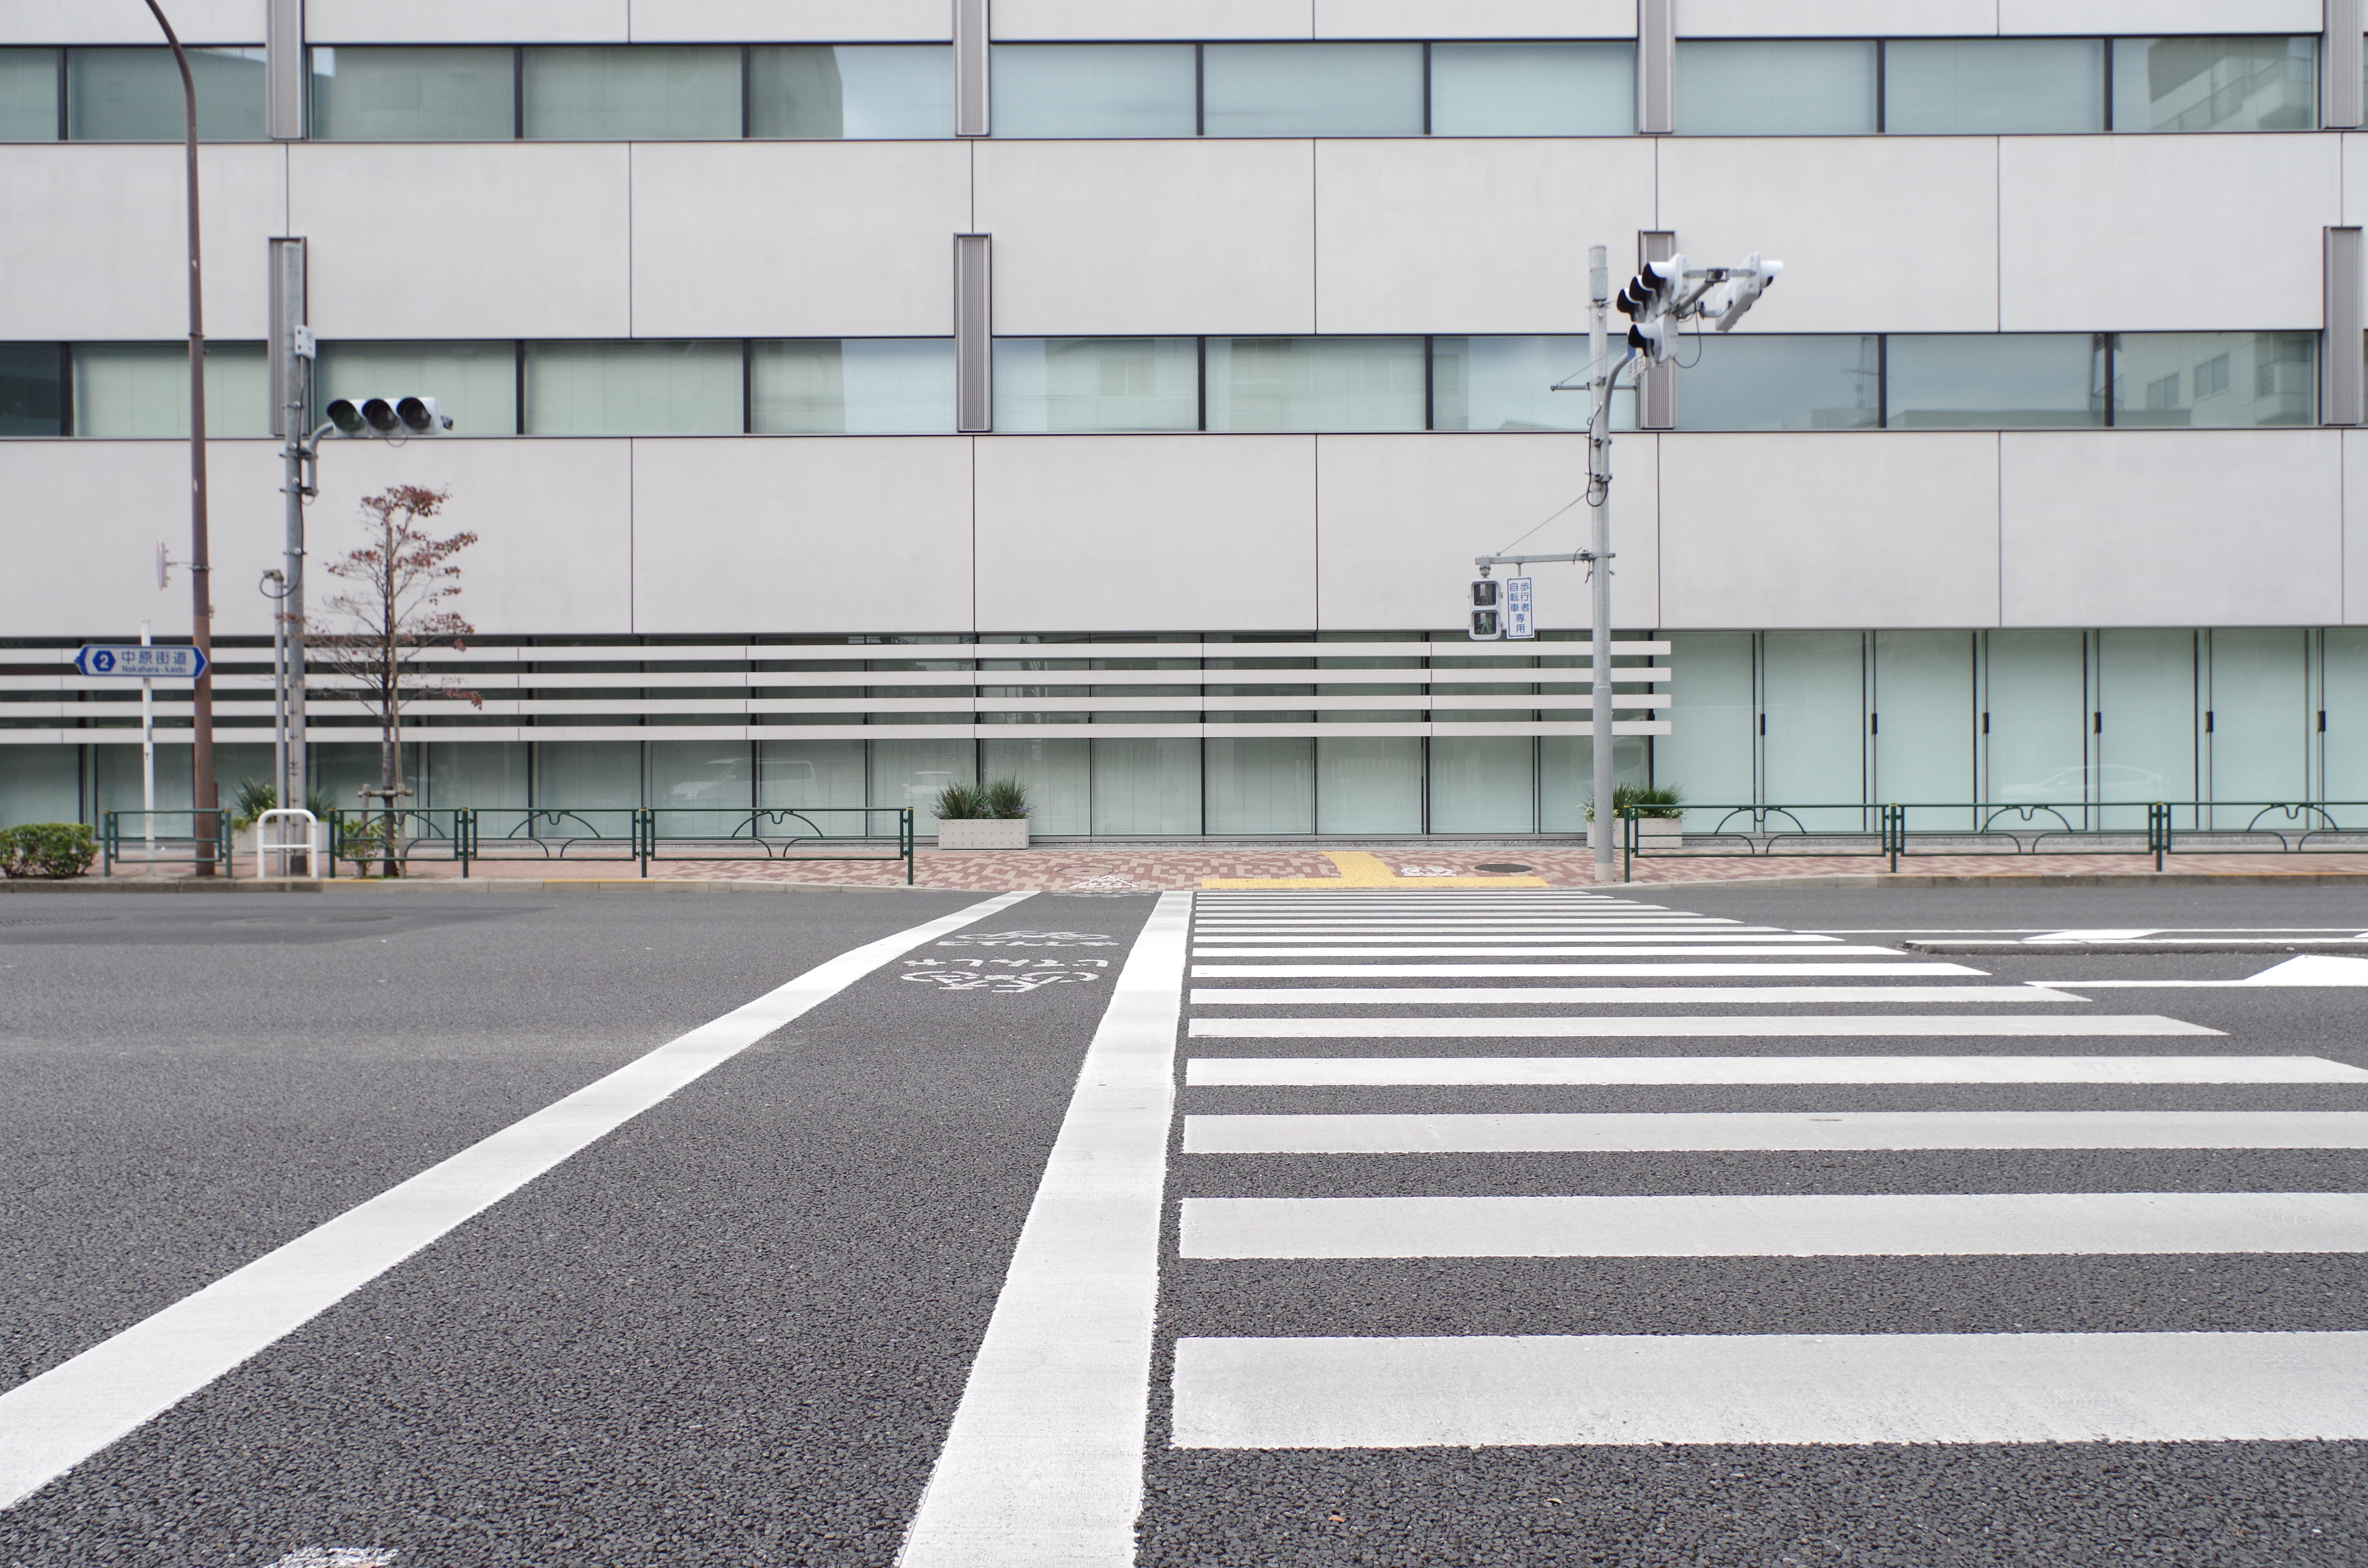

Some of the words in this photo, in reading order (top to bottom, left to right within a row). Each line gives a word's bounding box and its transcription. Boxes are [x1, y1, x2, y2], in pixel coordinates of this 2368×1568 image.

[1510, 582, 1519, 612] 自転車
[1520, 582, 1529, 612] 歩行者
[1516, 613, 1525, 633] 専用
[99, 654, 109, 669] 2
[122, 650, 187, 665] 中原街道
